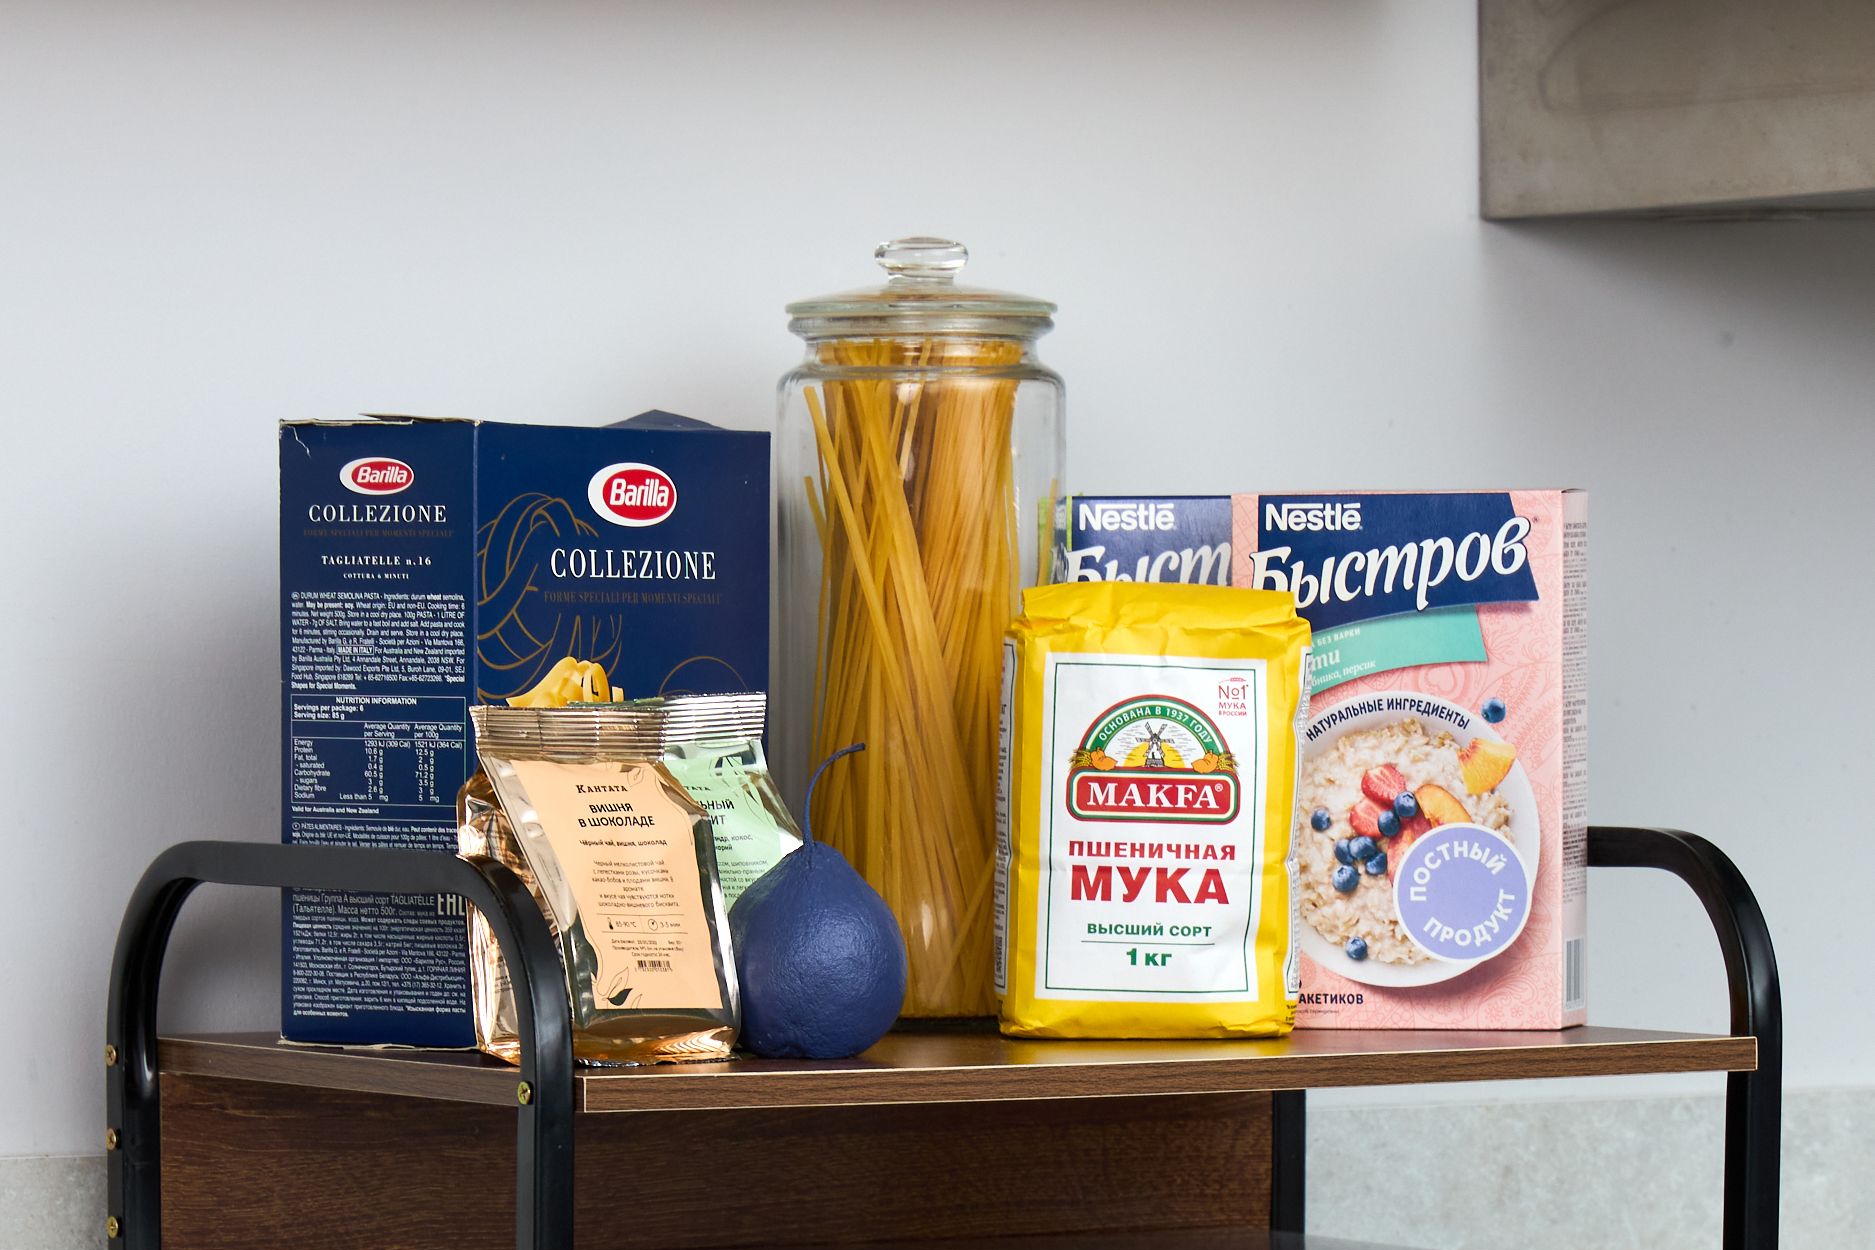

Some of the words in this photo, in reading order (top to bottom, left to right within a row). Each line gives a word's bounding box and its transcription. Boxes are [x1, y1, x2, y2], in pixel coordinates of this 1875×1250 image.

[357, 466, 408, 483] Barilla
[609, 478, 670, 507] Barilla
[308, 504, 447, 523] COLLEZIONE
[1079, 503, 1174, 531] Nestlé
[1266, 502, 1362, 531] Nestlé
[321, 555, 400, 566] TAGLIATELLE
[550, 548, 716, 580] COLLEZIONE
[1250, 516, 1531, 611] Быстров
[1317, 636, 1332, 647] БЕЗ
[1334, 627, 1360, 641] ВАРКИ
[1343, 660, 1376, 676] персик
[294, 704, 318, 712] Servings
[294, 711, 316, 720] Serving
[388, 723, 410, 731] Quantity
[1098, 706, 1151, 741] ОСНОВАНА
[1155, 707, 1161, 715] В
[1166, 707, 1188, 722] 1937
[1189, 721, 1213, 743] ГОДУ
[1306, 699, 1384, 742] НАТУРАЛЬНЫЕ
[1386, 697, 1471, 731] ИНГРЕДИЕНТЫ
[374, 731, 395, 739] Serving
[425, 732, 439, 740] 100g
[438, 724, 462, 732] Quantity
[294, 739, 313, 747] Energy
[294, 769, 330, 777] Carbohydrate
[589, 803, 633, 813] ВИШНЯ
[578, 818, 586, 827] В
[588, 816, 655, 827] ШОКОЛАДЕ
[1069, 840, 1236, 861] ПШЕНИЧНАЯ
[1409, 839, 1506, 902] ПОСТНЫЙ
[1070, 866, 1230, 905] МУКА
[321, 894, 343, 903] Группа
[349, 895, 374, 904] высший
[375, 896, 390, 905] сорт
[338, 905, 358, 915] Масса
[360, 907, 379, 916] нетто
[1422, 888, 1516, 946] ПРОДУКТ
[1087, 922, 1163, 936] ВЫСШИЙ
[1169, 926, 1212, 937] СОРТ
[1126, 948, 1137, 966] 1
[1298, 993, 1364, 1004] АКЕТИКОВ
